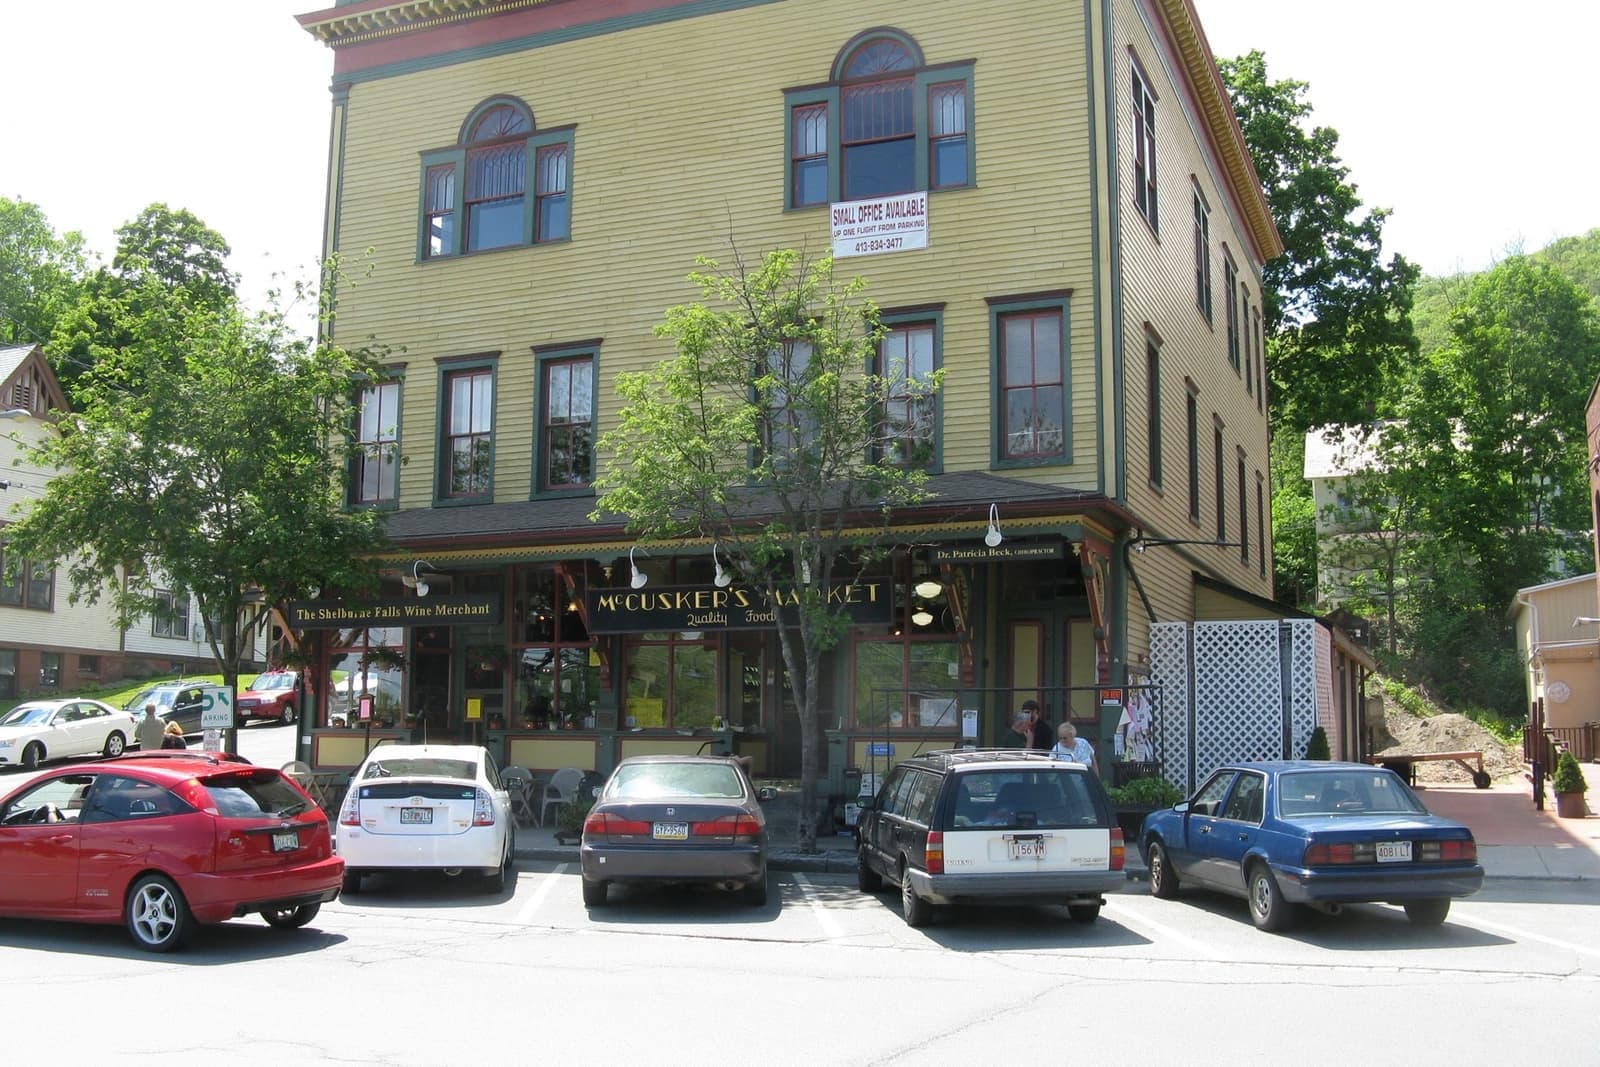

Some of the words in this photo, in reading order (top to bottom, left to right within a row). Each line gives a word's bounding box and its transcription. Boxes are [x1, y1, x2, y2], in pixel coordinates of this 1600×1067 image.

[833, 207, 855, 226] SMALL
[858, 203, 883, 223] OFFICE
[885, 198, 924, 218] AVAILABLE
[833, 229, 842, 238] UP
[843, 228, 856, 237] ONE
[856, 225, 877, 235] FLIGHT
[878, 224, 896, 233] FROM
[897, 220, 925, 230] PARKING
[855, 238, 903, 253] 413-834-3477
[937, 550, 951, 560] Dr.
[952, 548, 987, 559] Patricia
[988, 547, 1013, 557] Beck,
[296, 609, 316, 620] The
[375, 606, 401, 618] Falls
[403, 605, 432, 617] Wine
[435, 603, 490, 616] Merchant
[687, 611, 728, 627] Quality
